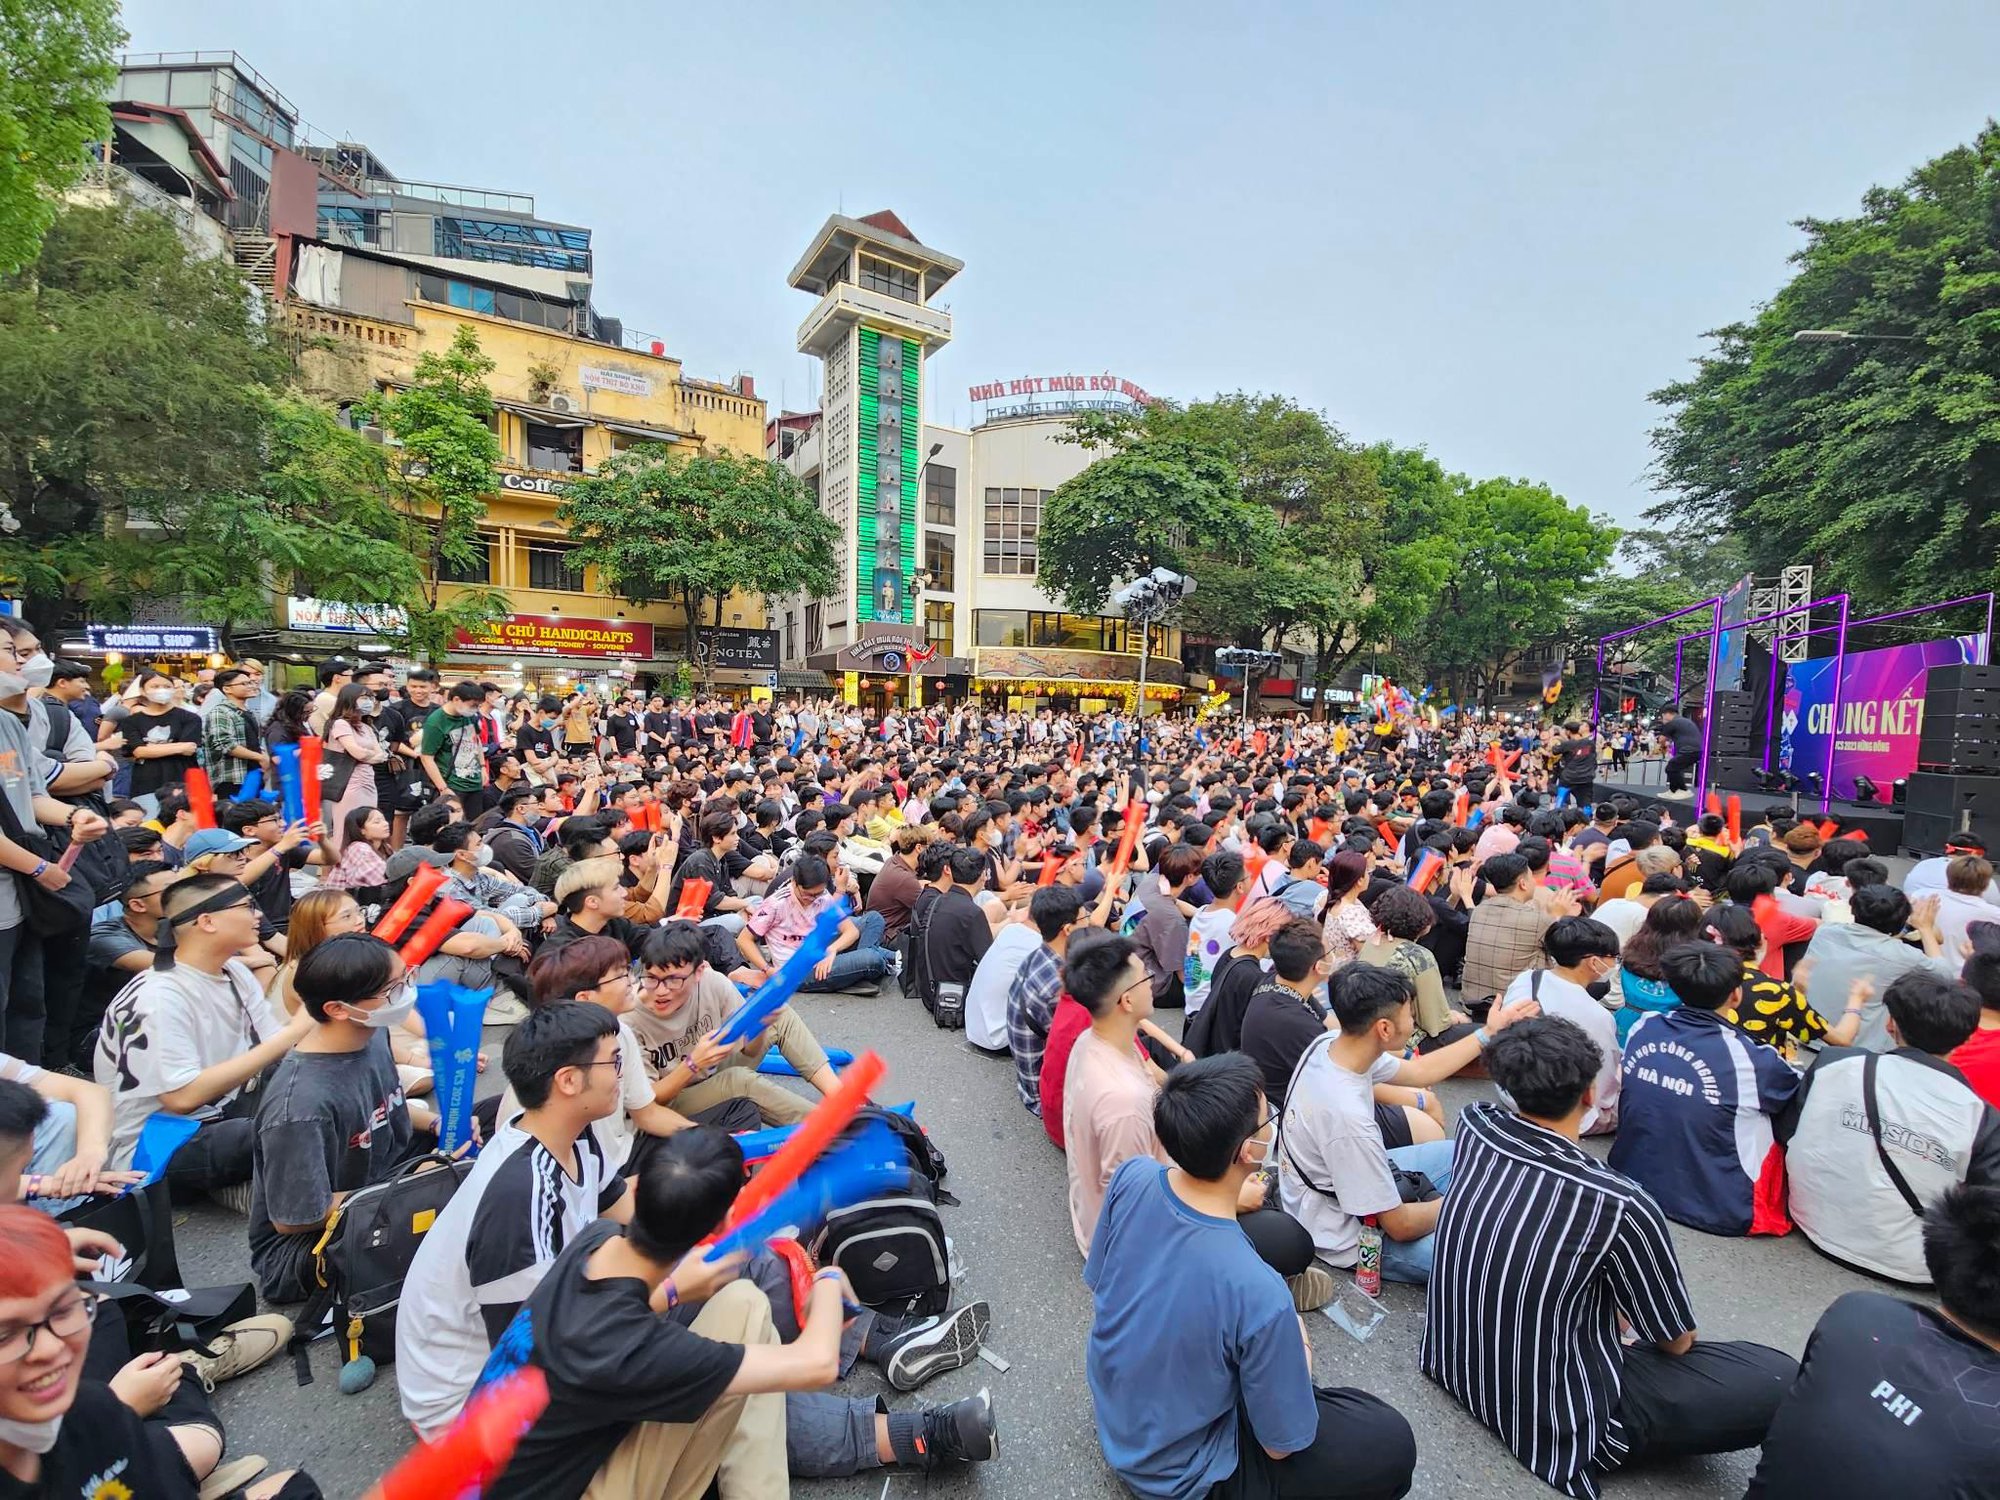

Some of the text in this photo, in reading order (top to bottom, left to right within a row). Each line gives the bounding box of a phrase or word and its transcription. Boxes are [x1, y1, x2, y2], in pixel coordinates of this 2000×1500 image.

[104, 633, 197, 647] SOUVENIR SHOP
[506, 621, 536, 637] CHỦ
[540, 627, 634, 644] HANDICRAFTS
[511, 638, 525, 646] TEA
[531, 639, 586, 650] CONFECTIONERY
[592, 642, 625, 651] SOUVENIR
[697, 640, 762, 659] DNG TEA
[1635, 1042, 1657, 1060] HỌC
[1659, 1040, 1695, 1062] CÔNG
[1691, 1059, 1722, 1105] NGHIỆP
[1637, 1067, 1695, 1097] HÀ NỘI
[450, 1086, 464, 1107] 2023
[1359, 1246, 1379, 1268] C2
